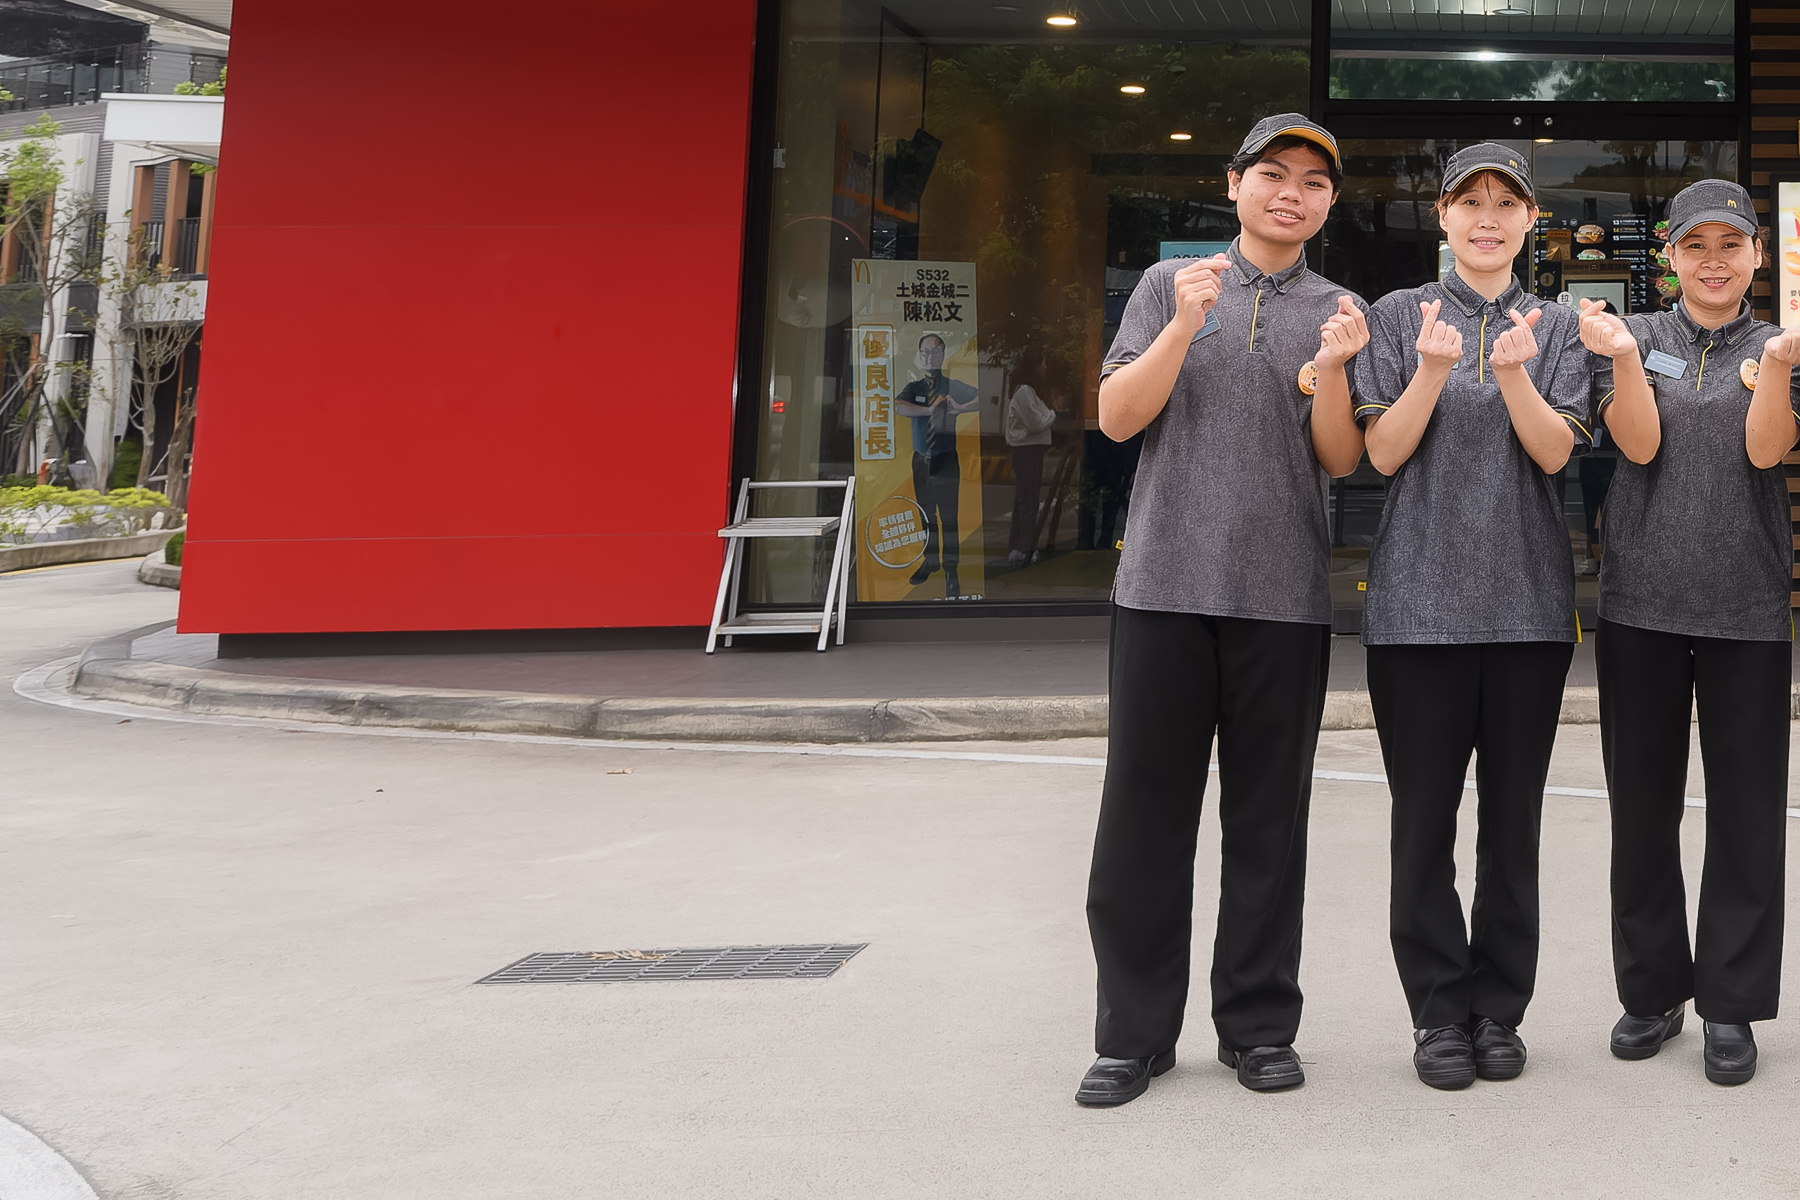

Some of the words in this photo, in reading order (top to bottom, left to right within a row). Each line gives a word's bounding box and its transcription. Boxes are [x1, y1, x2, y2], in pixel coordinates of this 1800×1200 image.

[916, 269, 950, 281] S532
[896, 282, 969, 298] 土城金城二
[903, 301, 963, 323] 陳松文
[863, 330, 891, 455] 優良店長
